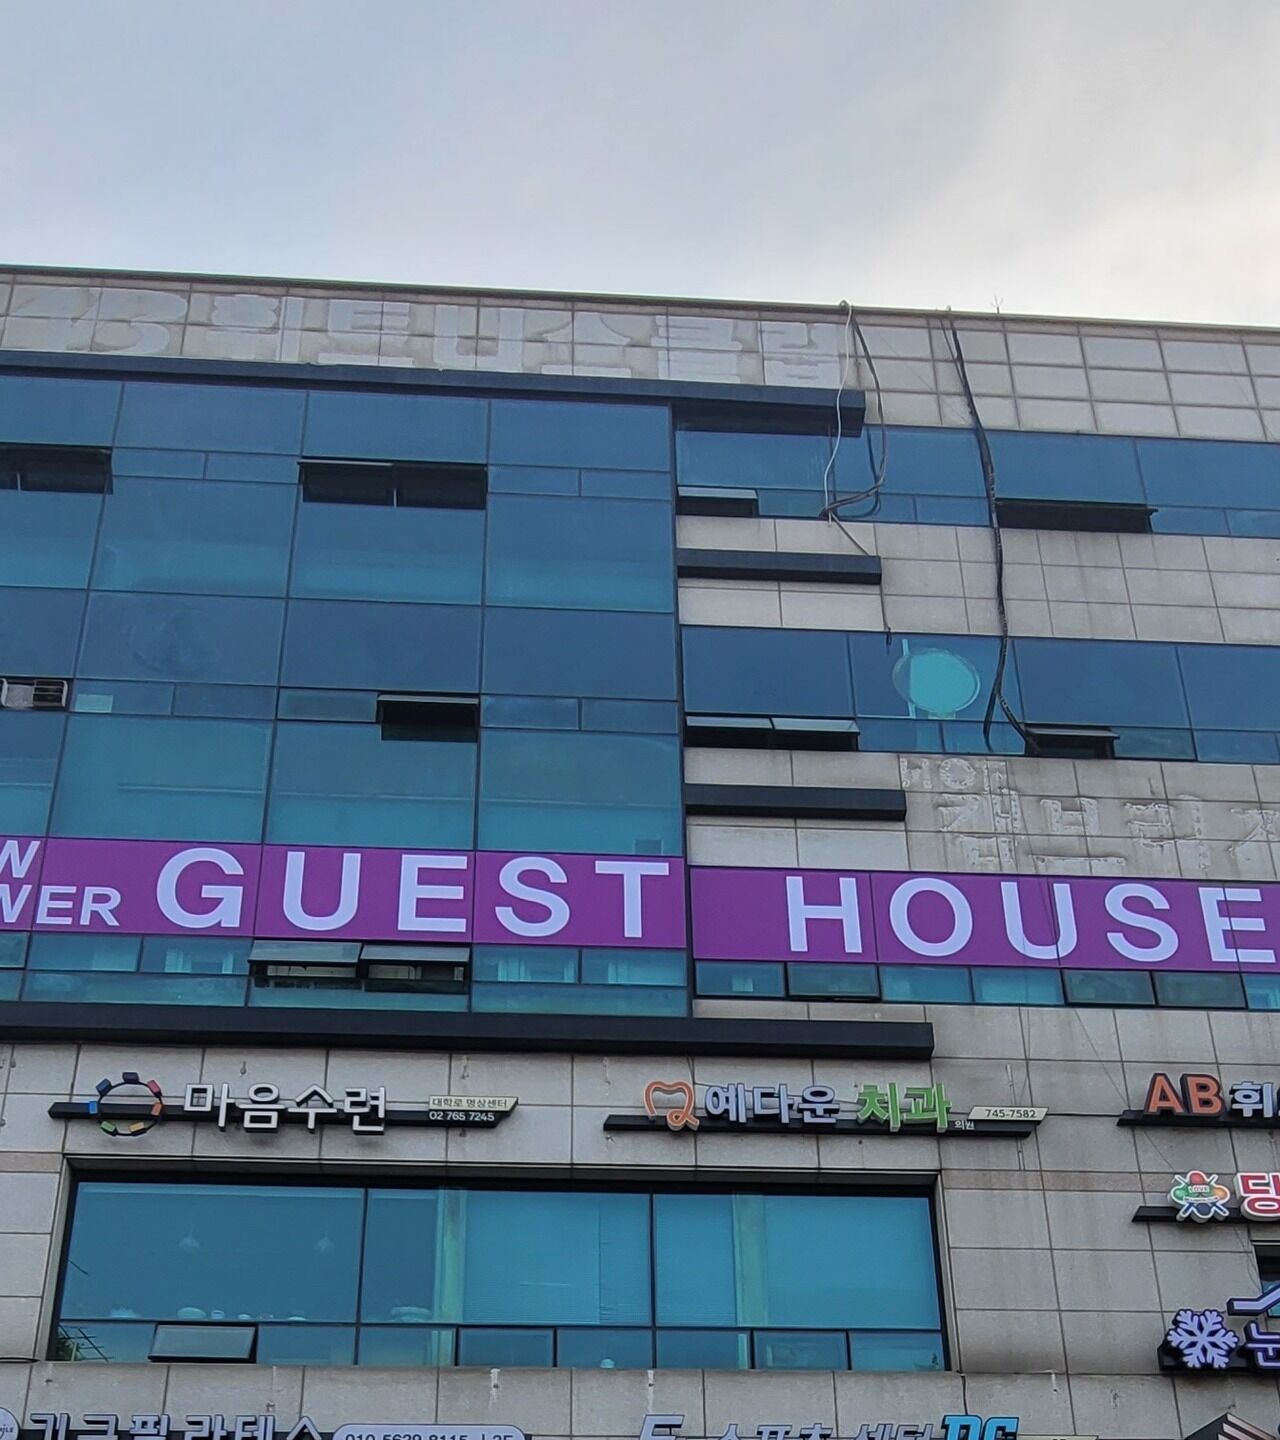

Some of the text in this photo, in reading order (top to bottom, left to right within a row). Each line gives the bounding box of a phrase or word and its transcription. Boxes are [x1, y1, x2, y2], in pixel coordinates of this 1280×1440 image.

[156, 846, 1277, 965] GUEST HOUSE
[184, 1081, 388, 1135] 마음수련
[429, 1111, 495, 1122] 02 765 7245
[432, 1097, 463, 1108] 대학로
[855, 1081, 952, 1133] 치과
[983, 1107, 1038, 1119] 745-7582
[1145, 1071, 1223, 1118] AB
